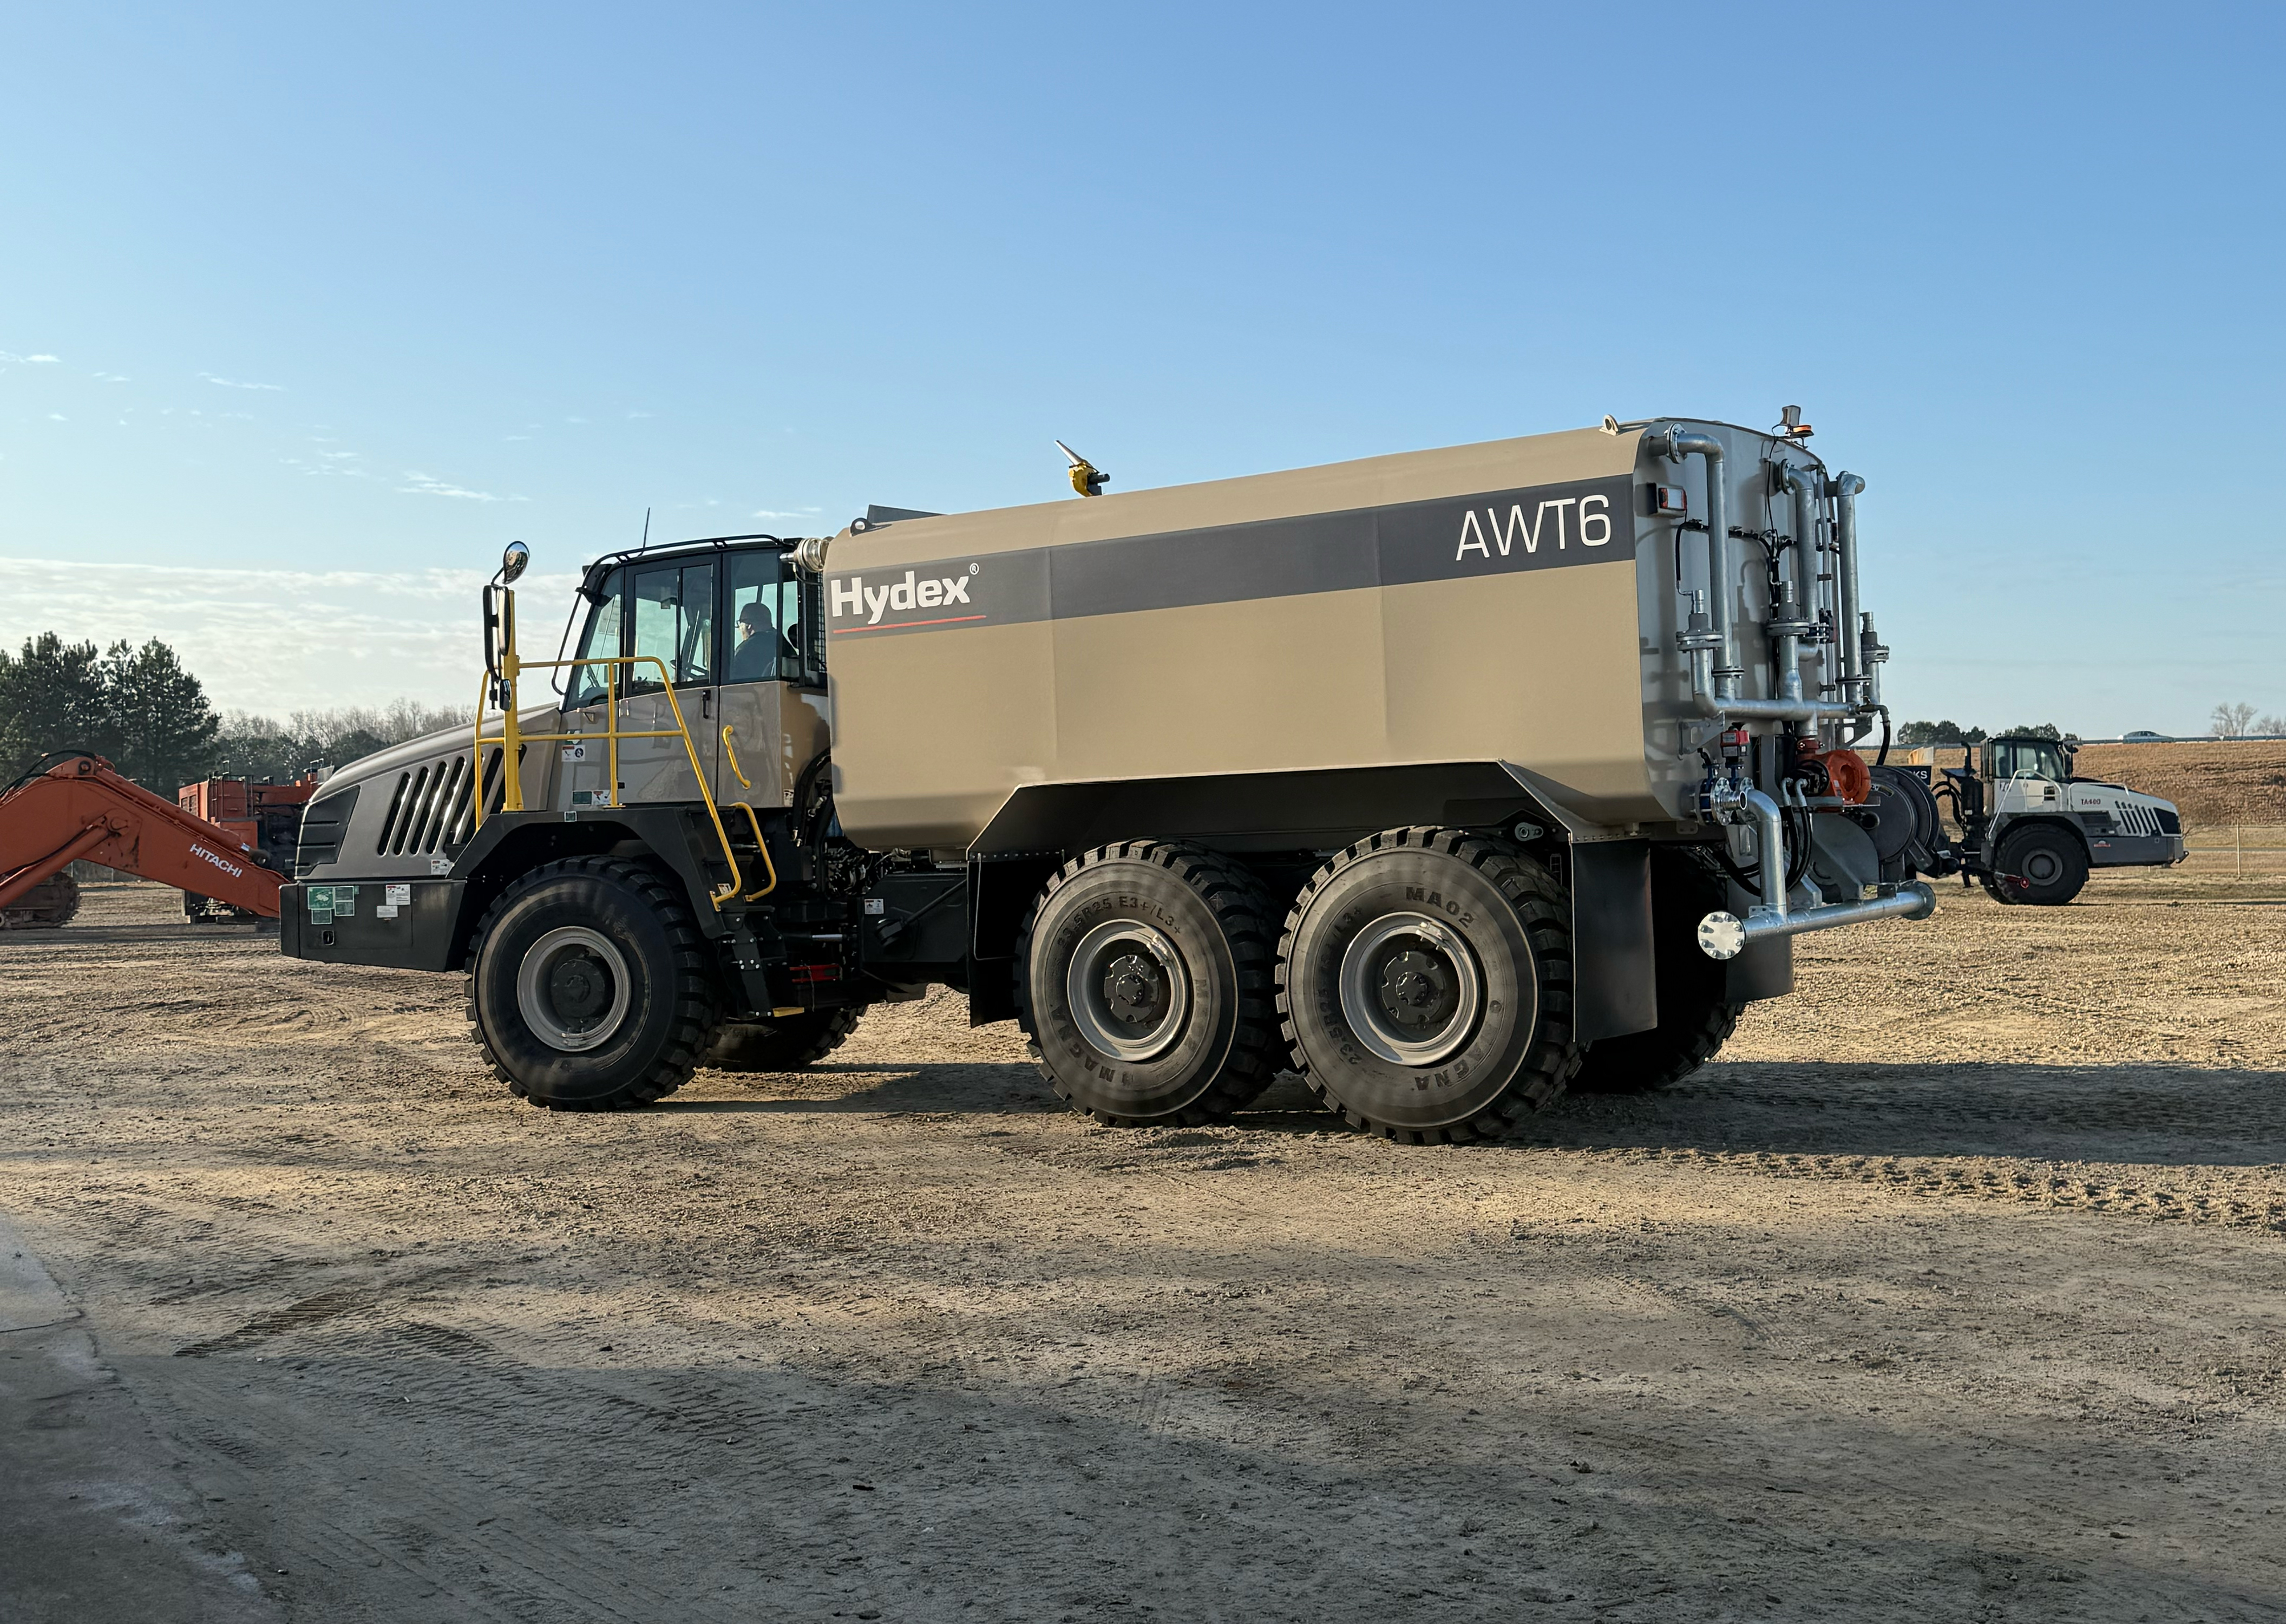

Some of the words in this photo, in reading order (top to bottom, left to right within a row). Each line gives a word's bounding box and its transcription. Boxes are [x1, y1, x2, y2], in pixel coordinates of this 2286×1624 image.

[1456, 494, 1613, 561] AWT6
[189, 843, 243, 878] HITACHI
[1051, 1004, 1116, 1082] MAGNA
